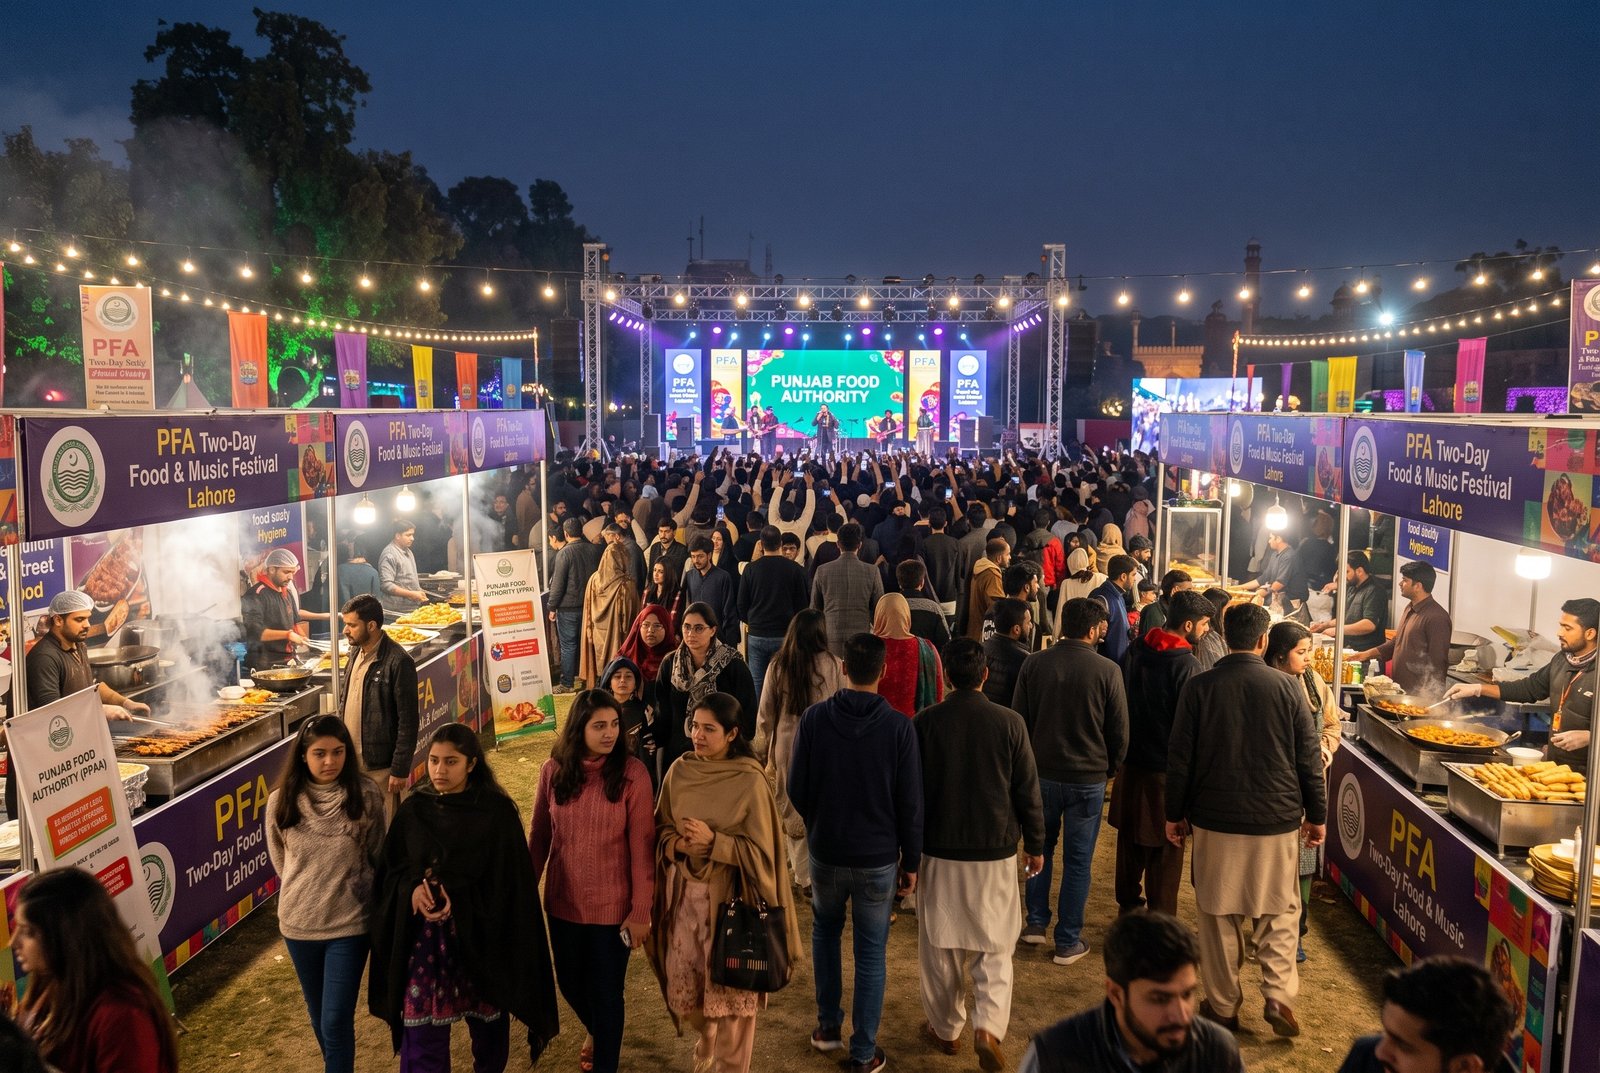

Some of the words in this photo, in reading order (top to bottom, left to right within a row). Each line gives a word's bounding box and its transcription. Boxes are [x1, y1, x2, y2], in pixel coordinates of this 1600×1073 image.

[92, 338, 140, 356] PFA
[89, 358, 124, 368] Two-Day
[716, 356, 737, 365] PFA
[914, 357, 936, 366] PFA
[673, 378, 694, 387] PFA
[771, 374, 832, 388] PUNJAB
[837, 375, 880, 388] FOOD
[957, 379, 979, 388] PFA
[780, 390, 870, 403] AUTHORITY
[390, 421, 406, 440] PFA
[408, 424, 433, 441] Two-Day
[1257, 424, 1270, 442] PFA
[1272, 428, 1295, 448] Two-Day
[157, 428, 196, 456] PFA
[200, 430, 257, 455] Two-Day
[378, 445, 395, 462] Food
[397, 445, 402, 459] &
[403, 443, 420, 459] Music
[1406, 432, 1433, 460] PFA
[1436, 440, 1490, 472] Two-Day
[1248, 444, 1260, 460] Food
[1261, 446, 1265, 460] &
[1266, 446, 1281, 462] Music
[1282, 448, 1304, 466] Festival
[130, 462, 169, 487] Food
[174, 462, 185, 483] &
[189, 458, 229, 482] Music
[232, 454, 278, 477] Festival
[402, 462, 424, 478] Lahore
[1264, 465, 1283, 483] Lahore
[1388, 461, 1412, 484] Food
[1415, 465, 1422, 486] &
[1425, 466, 1458, 492] Music
[1461, 471, 1512, 500] Festival
[188, 486, 236, 509] Lahore
[1422, 492, 1462, 521] Lahore
[252, 512, 269, 525] food
[1408, 522, 1420, 535] food
[258, 527, 287, 544] Hygiene
[1409, 538, 1434, 556] Hygiene
[21, 556, 54, 577] treet
[484, 588, 515, 597] AUTHORITY
[418, 677, 435, 709] FA
[38, 760, 72, 783] PUNJAB
[73, 749, 96, 768] FOOD
[32, 773, 79, 803] AUTHORITY
[81, 758, 107, 781] (PPAA)
[215, 774, 270, 842] PFA
[186, 846, 234, 888] Two-Day
[237, 823, 262, 855] Food
[1390, 809, 1436, 893] PFA
[225, 851, 267, 892] Lahore
[1369, 838, 1401, 889] Two-Day
[1403, 872, 1425, 910] Food
[1425, 895, 1433, 919] &
[1435, 904, 1464, 949] Music
[1393, 892, 1426, 943] Lahore
